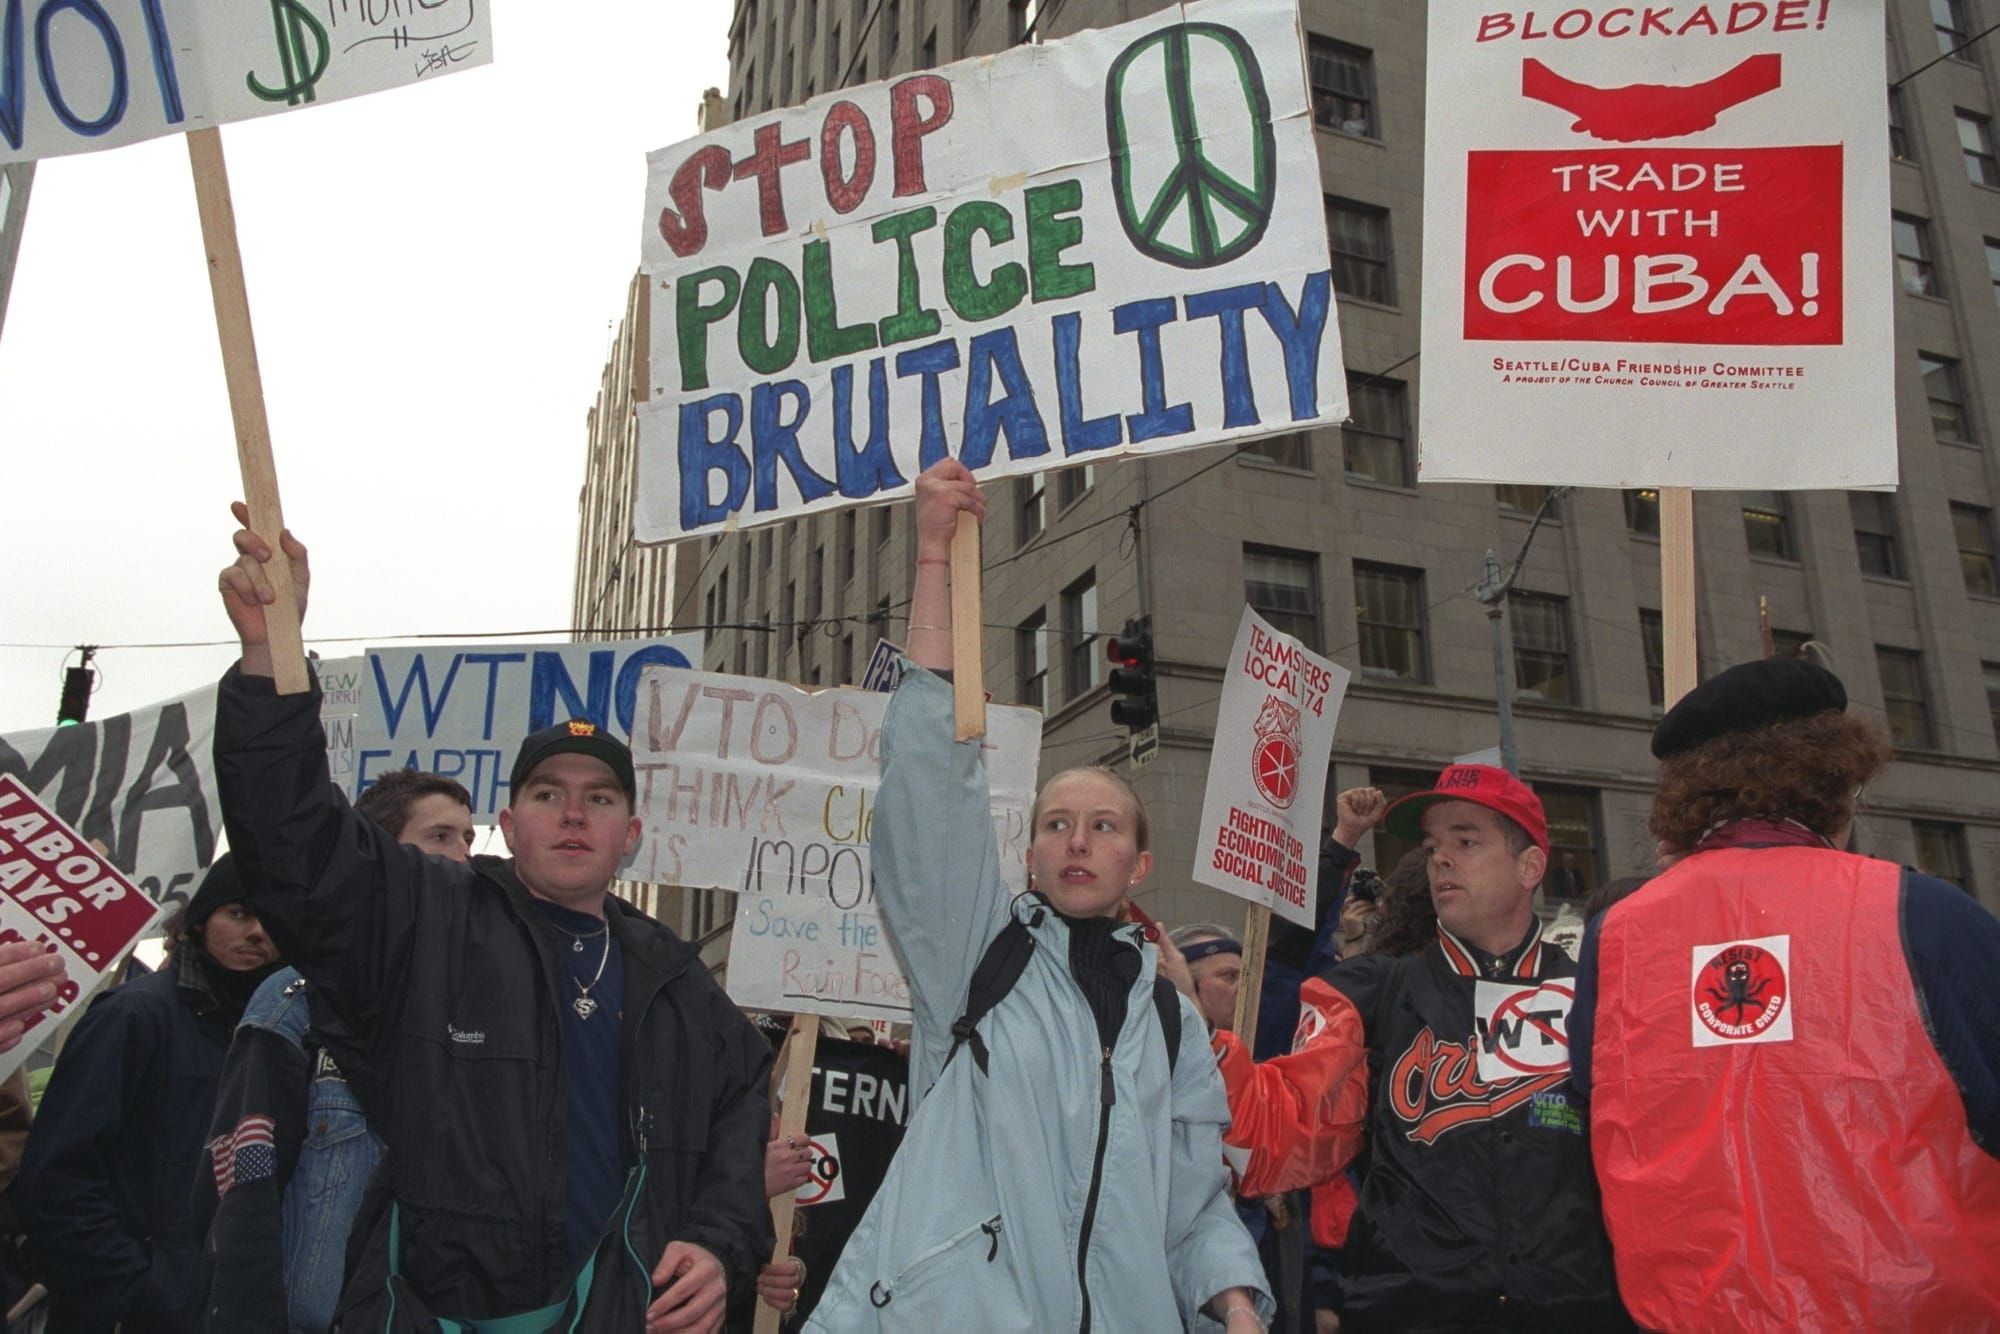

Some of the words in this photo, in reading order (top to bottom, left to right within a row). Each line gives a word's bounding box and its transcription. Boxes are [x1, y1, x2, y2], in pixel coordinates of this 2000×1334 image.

[1476, 0, 1829, 42] BLOCKADE!
[1552, 163, 1745, 192] TRADE
[1576, 209, 1718, 237] WITH
[677, 179, 1095, 391] POLICE
[1479, 252, 1819, 316] CUBA!
[679, 269, 1331, 531] BRUTALITY
[1244, 650, 1297, 698] LOCAL
[1250, 623, 1332, 694] TEAMSTERS
[636, 762, 796, 837] THINK
[1218, 826, 1286, 873] ECONOMIC
[1286, 858, 1307, 885] AND
[1229, 806, 1286, 850] FIGHTING
[1286, 835, 1304, 862] FOR
[745, 836, 875, 910] IMPO
[1213, 848, 1264, 885] SOCIAL
[1267, 871, 1306, 908] JUSTICE
[750, 899, 819, 941] Save
[837, 912, 879, 951] the
[1699, 1002, 1754, 1036] CORPORATE
[1755, 995, 1782, 1029] GREED
